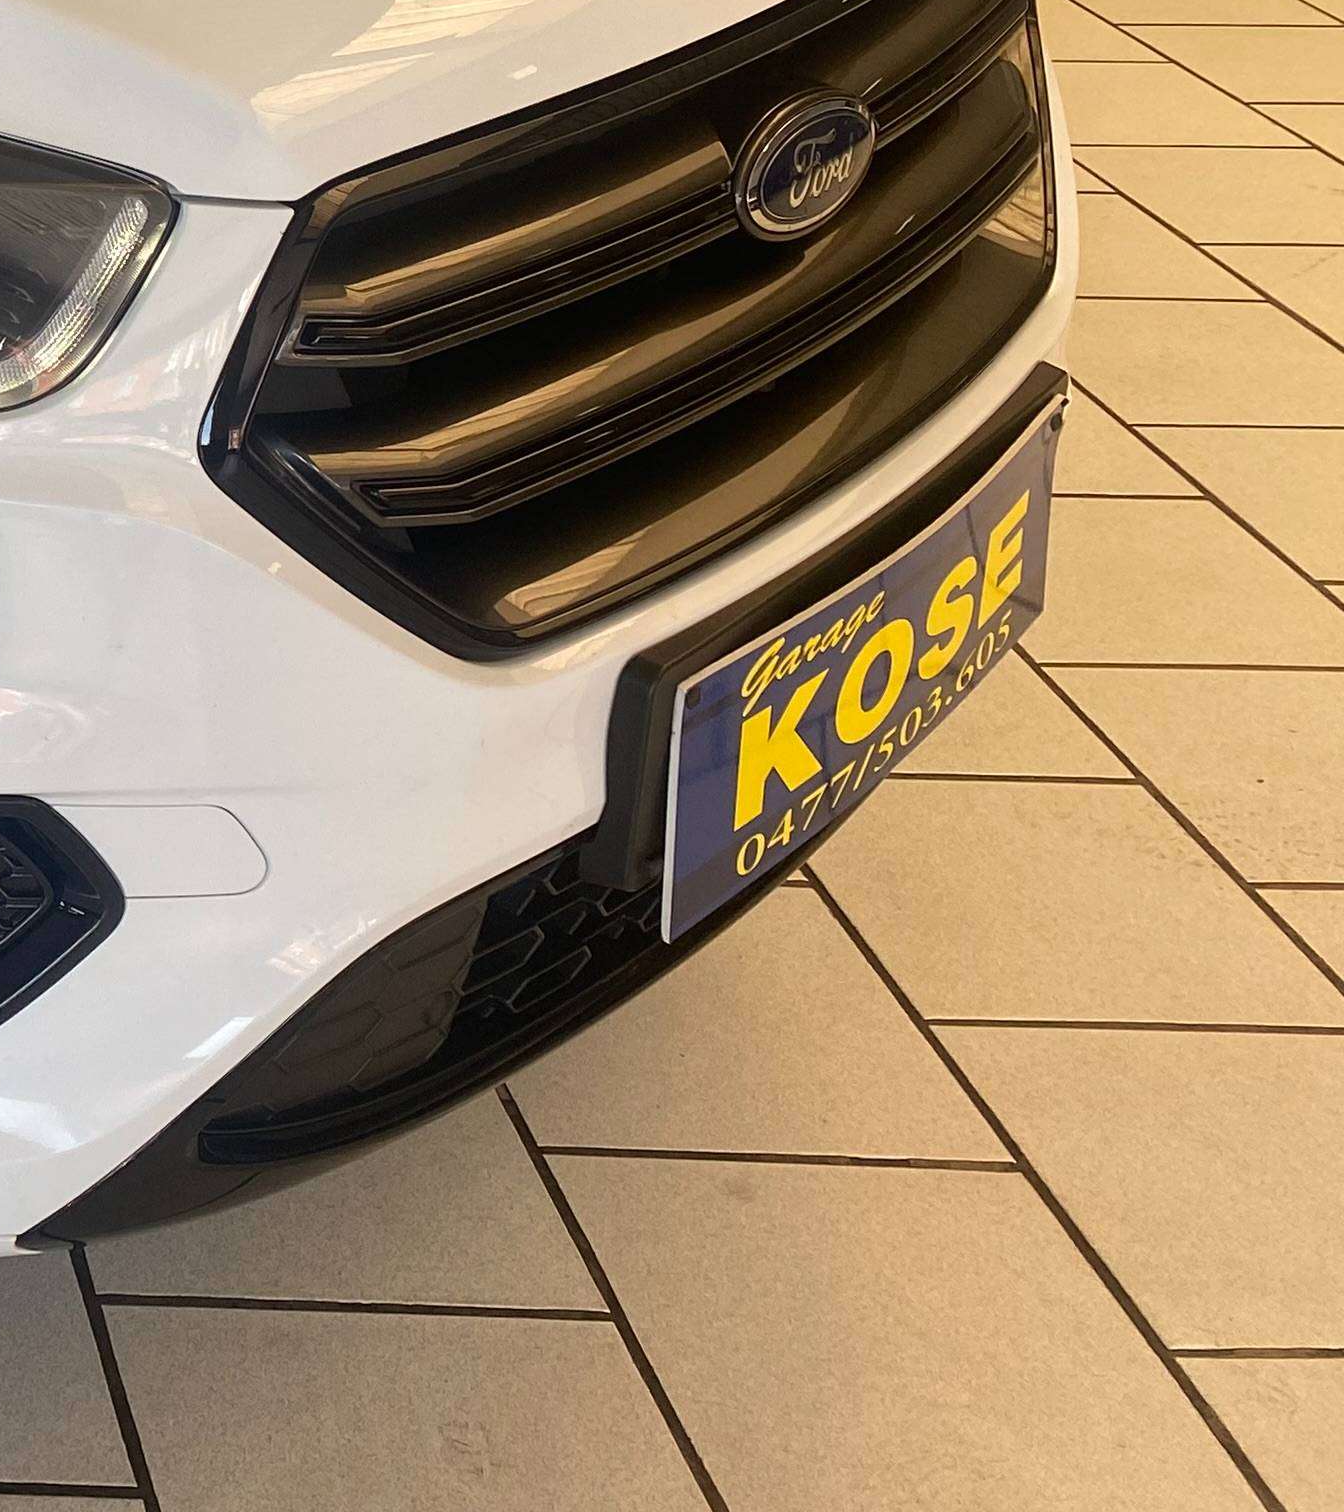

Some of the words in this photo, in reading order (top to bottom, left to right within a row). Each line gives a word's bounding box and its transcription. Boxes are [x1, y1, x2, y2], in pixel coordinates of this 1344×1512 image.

[790, 128, 855, 208] Ford
[735, 489, 1030, 831] KOSE
[736, 609, 1012, 876] 0477/503.605
[741, 591, 885, 717] Garage
